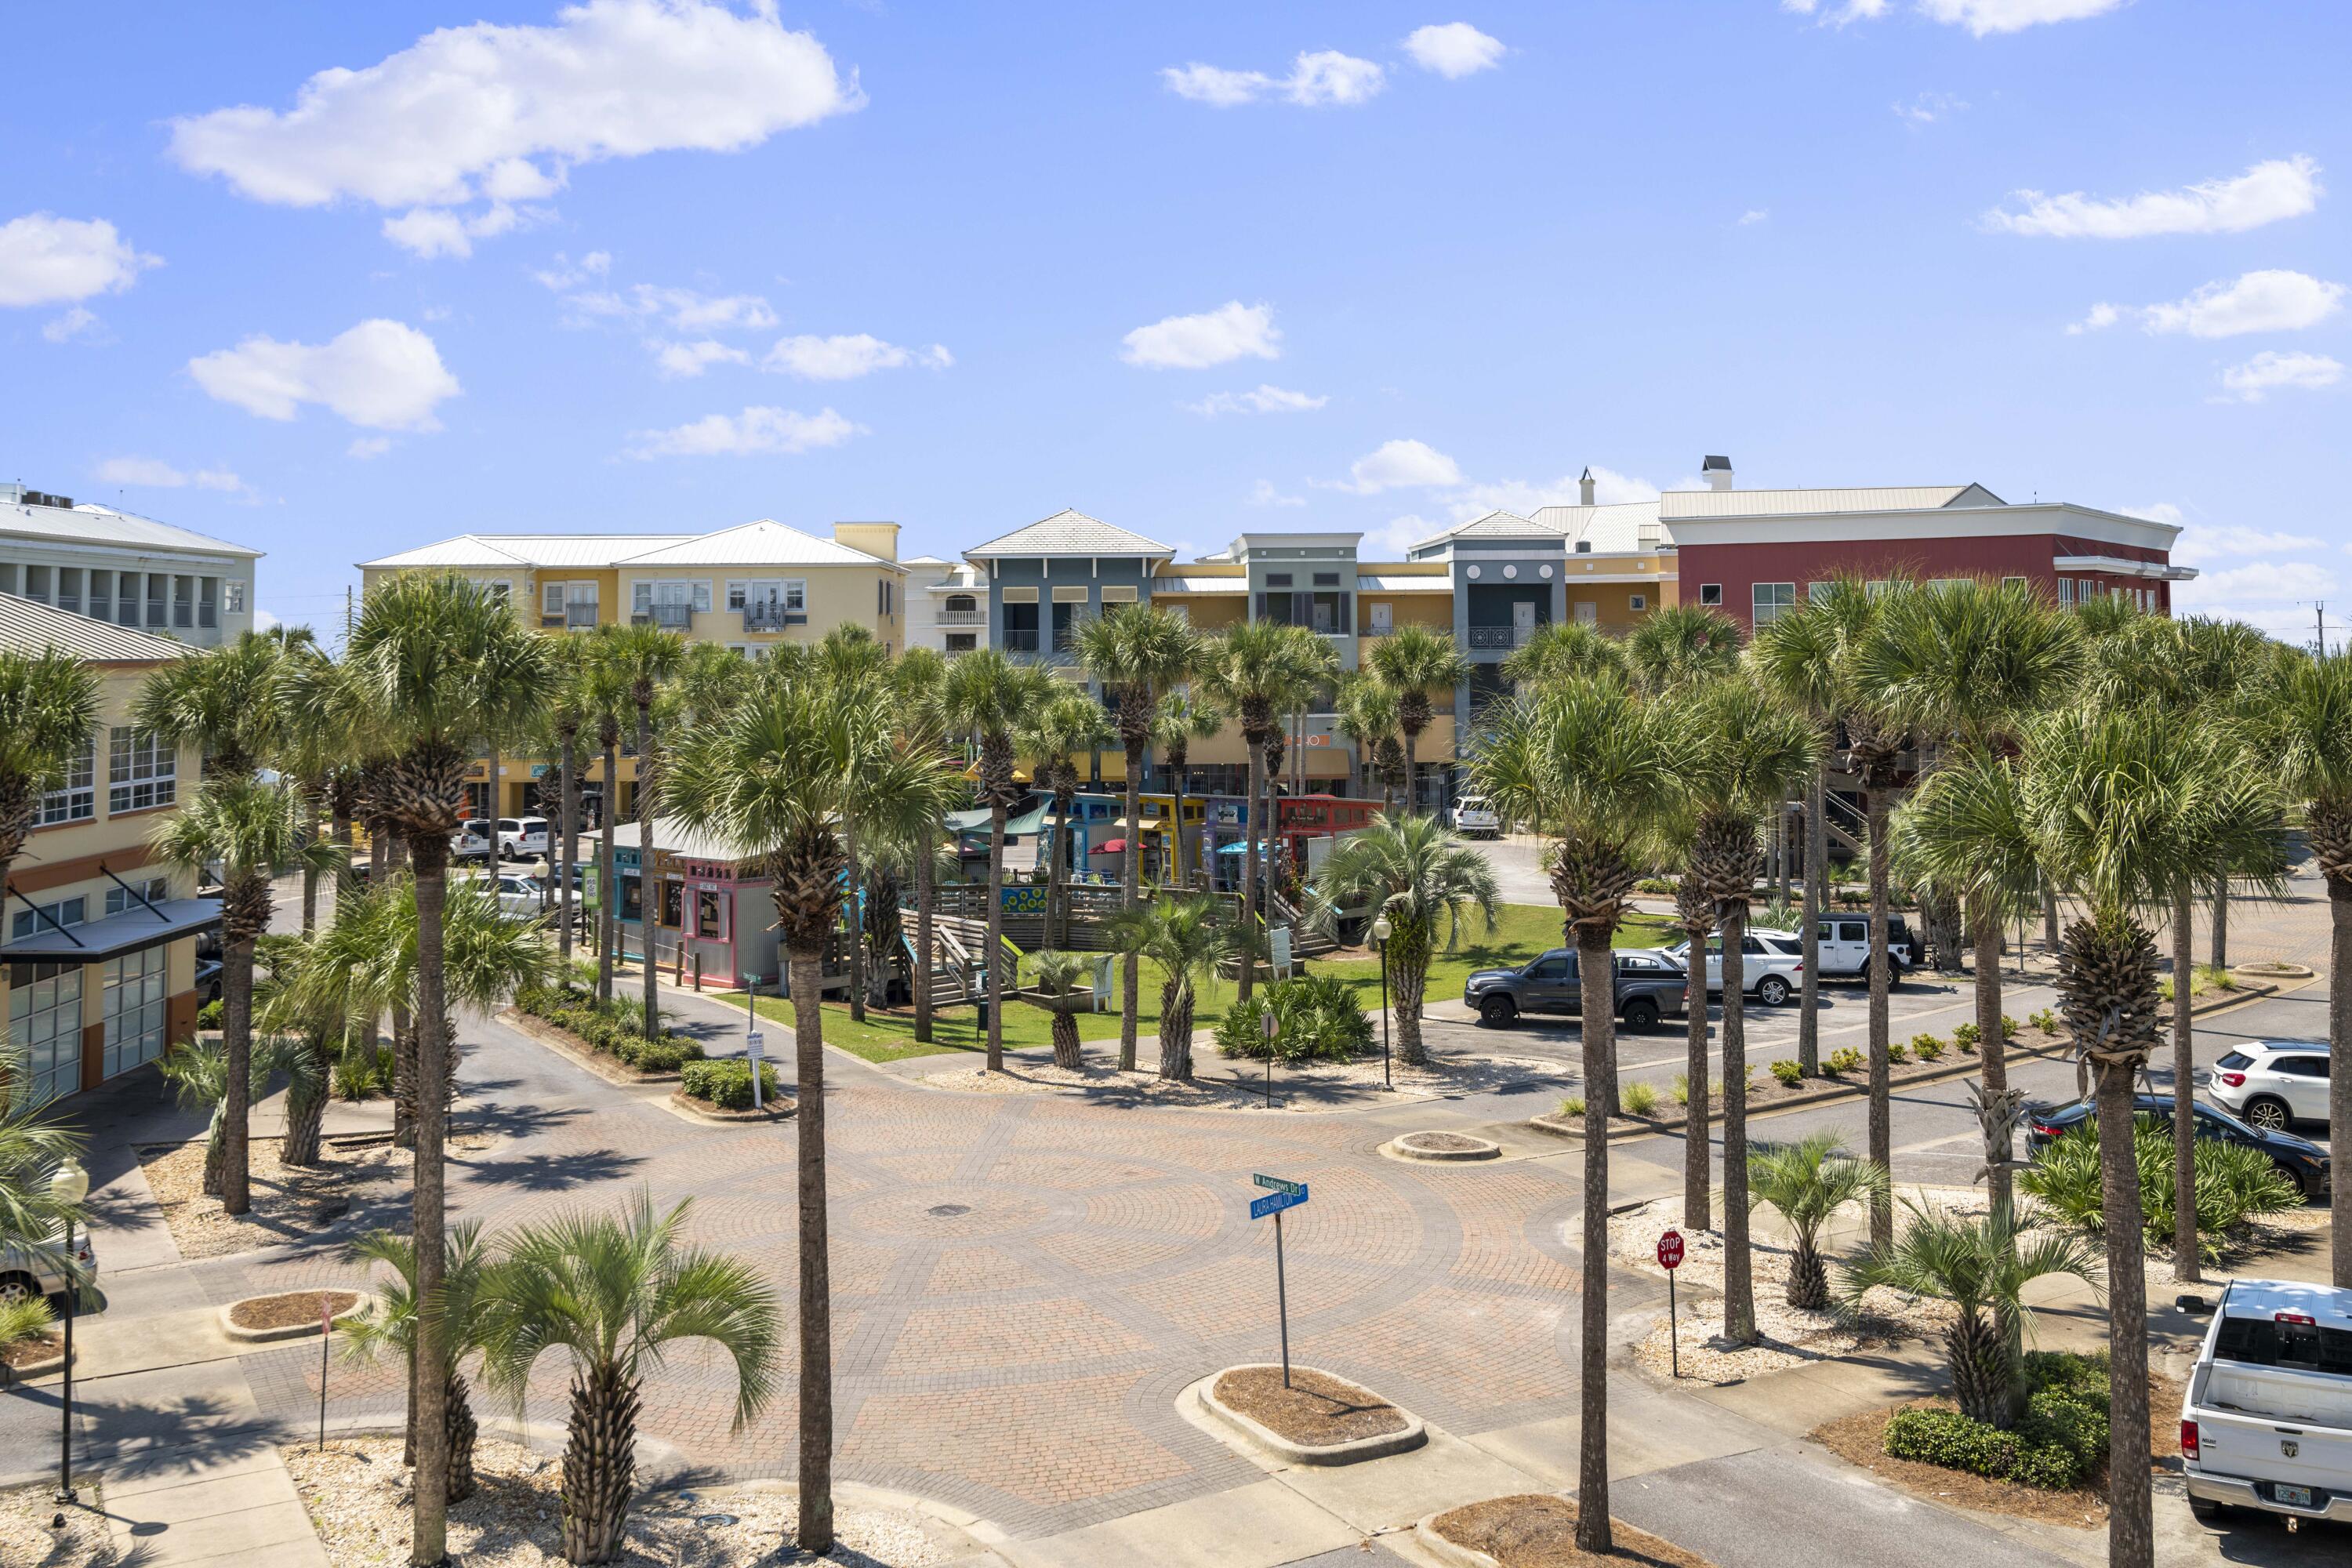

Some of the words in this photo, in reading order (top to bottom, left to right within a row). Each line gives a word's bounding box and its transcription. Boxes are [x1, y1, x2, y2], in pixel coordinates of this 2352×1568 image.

[1254, 1175, 1260, 1185] W
[1262, 1177, 1289, 1192] Andrews
[1290, 1184, 1298, 1193] Dr
[1254, 1200, 1270, 1217] LAURA
[1270, 1193, 1293, 1211] HAMILTON
[1661, 1237, 1681, 1251] STOP
[1668, 1253, 1680, 1262] Way
